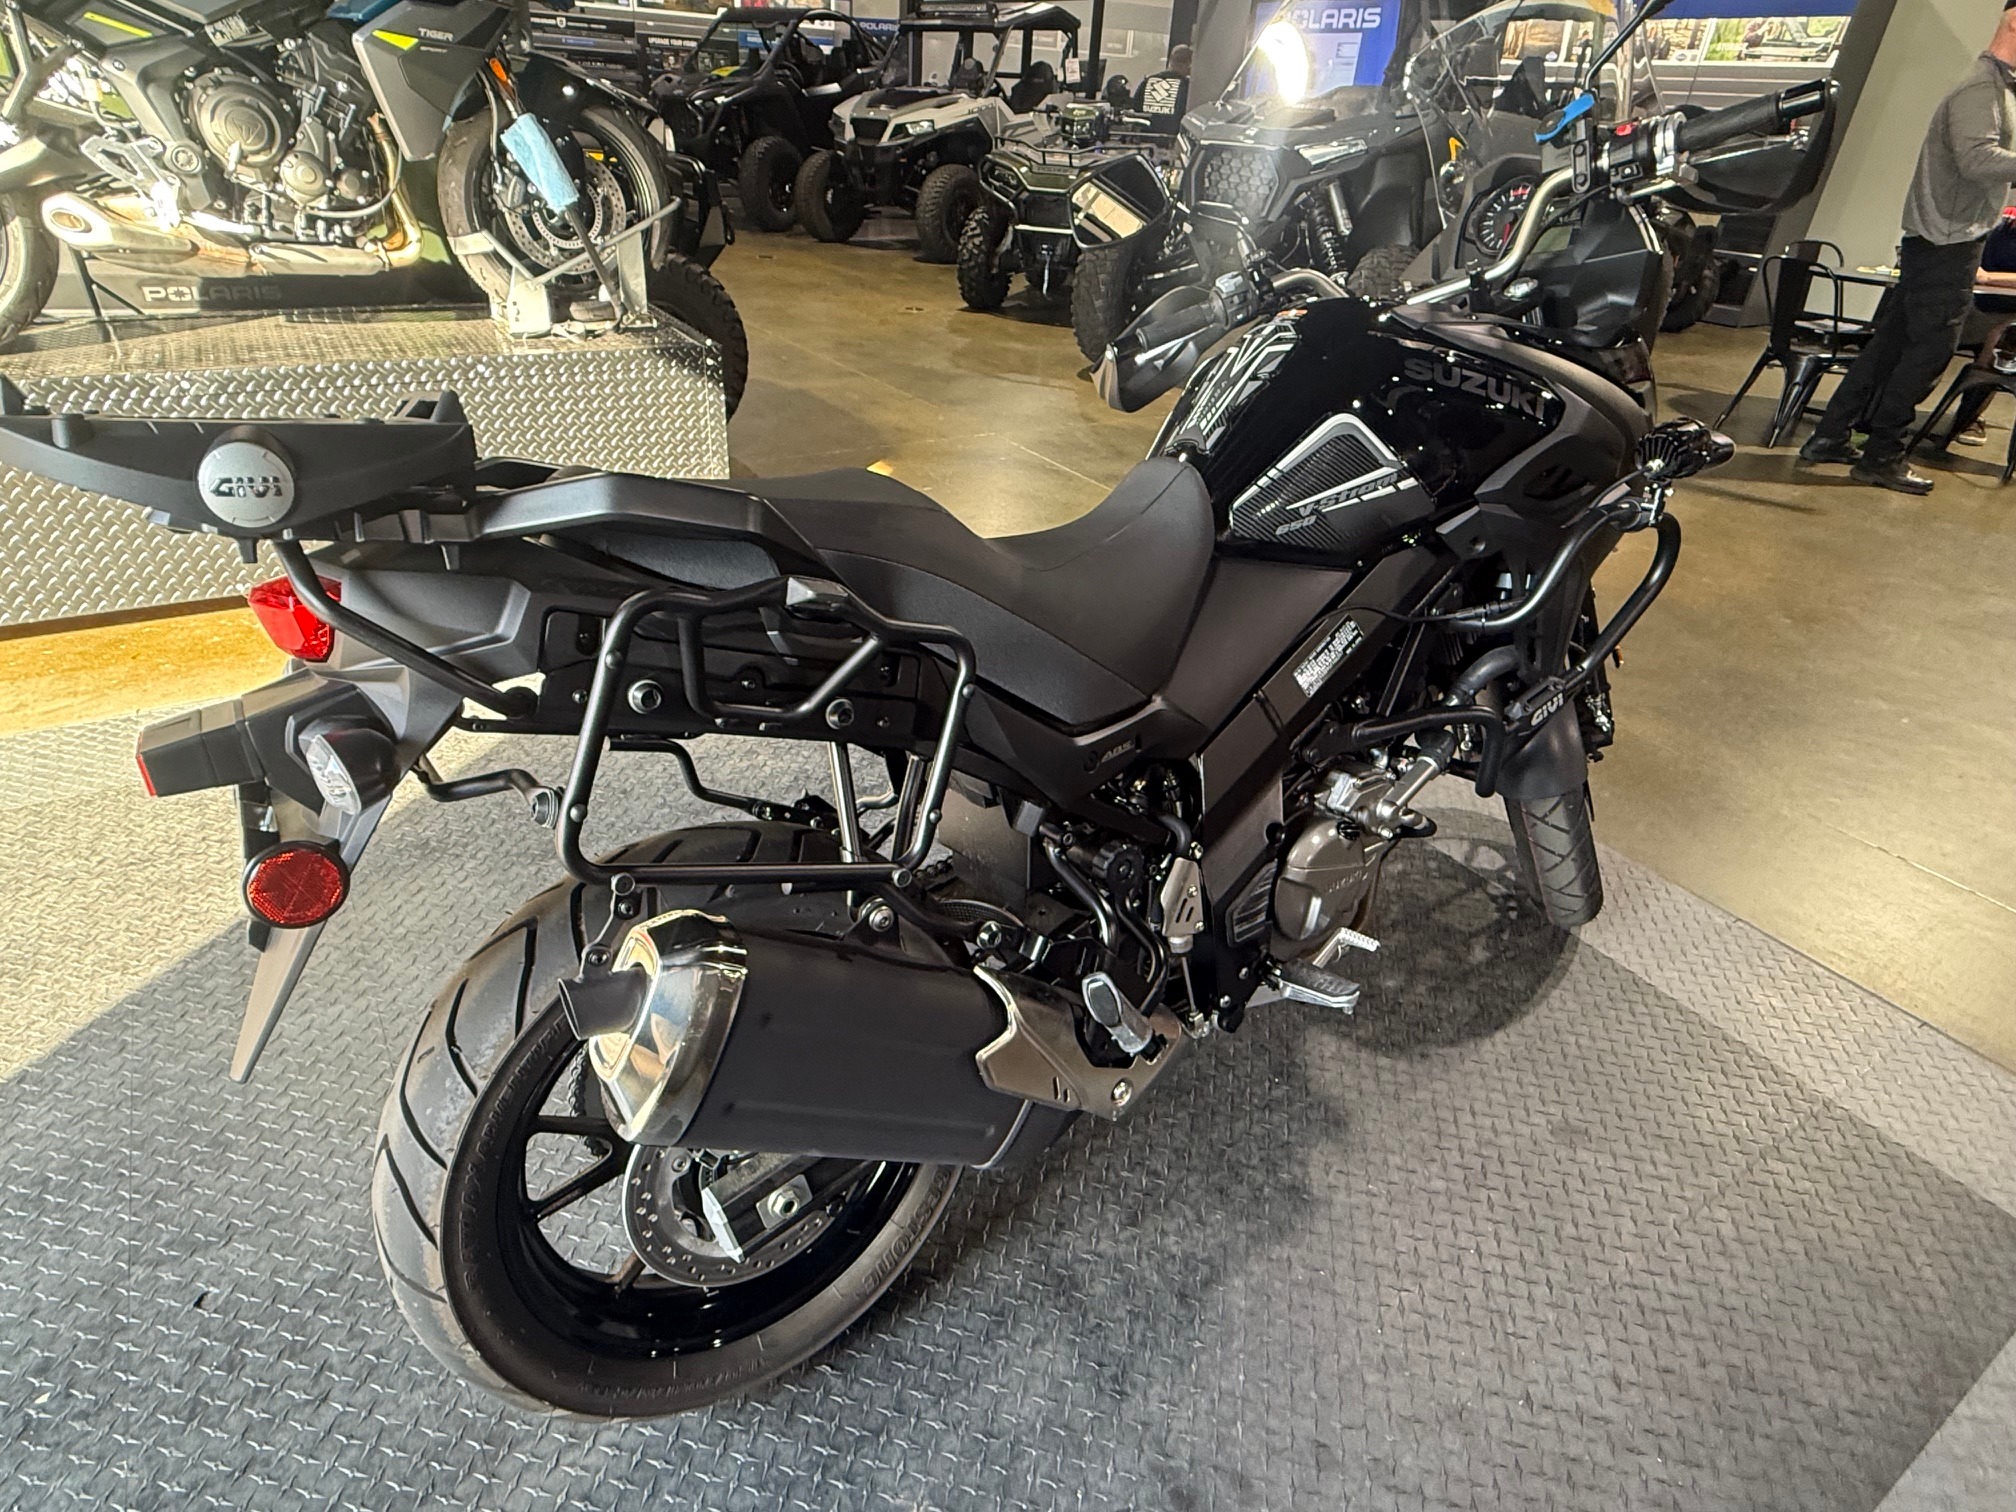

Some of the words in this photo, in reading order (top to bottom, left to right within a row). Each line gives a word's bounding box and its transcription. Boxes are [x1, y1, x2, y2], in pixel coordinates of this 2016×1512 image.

[418, 27, 455, 42] TIGER
[1142, 105, 1175, 115] SUZUKI
[141, 285, 282, 302] POLARIS
[1403, 357, 1547, 421] SUZUKI
[1274, 514, 1318, 536] 650
[1530, 691, 1565, 727] GIVI
